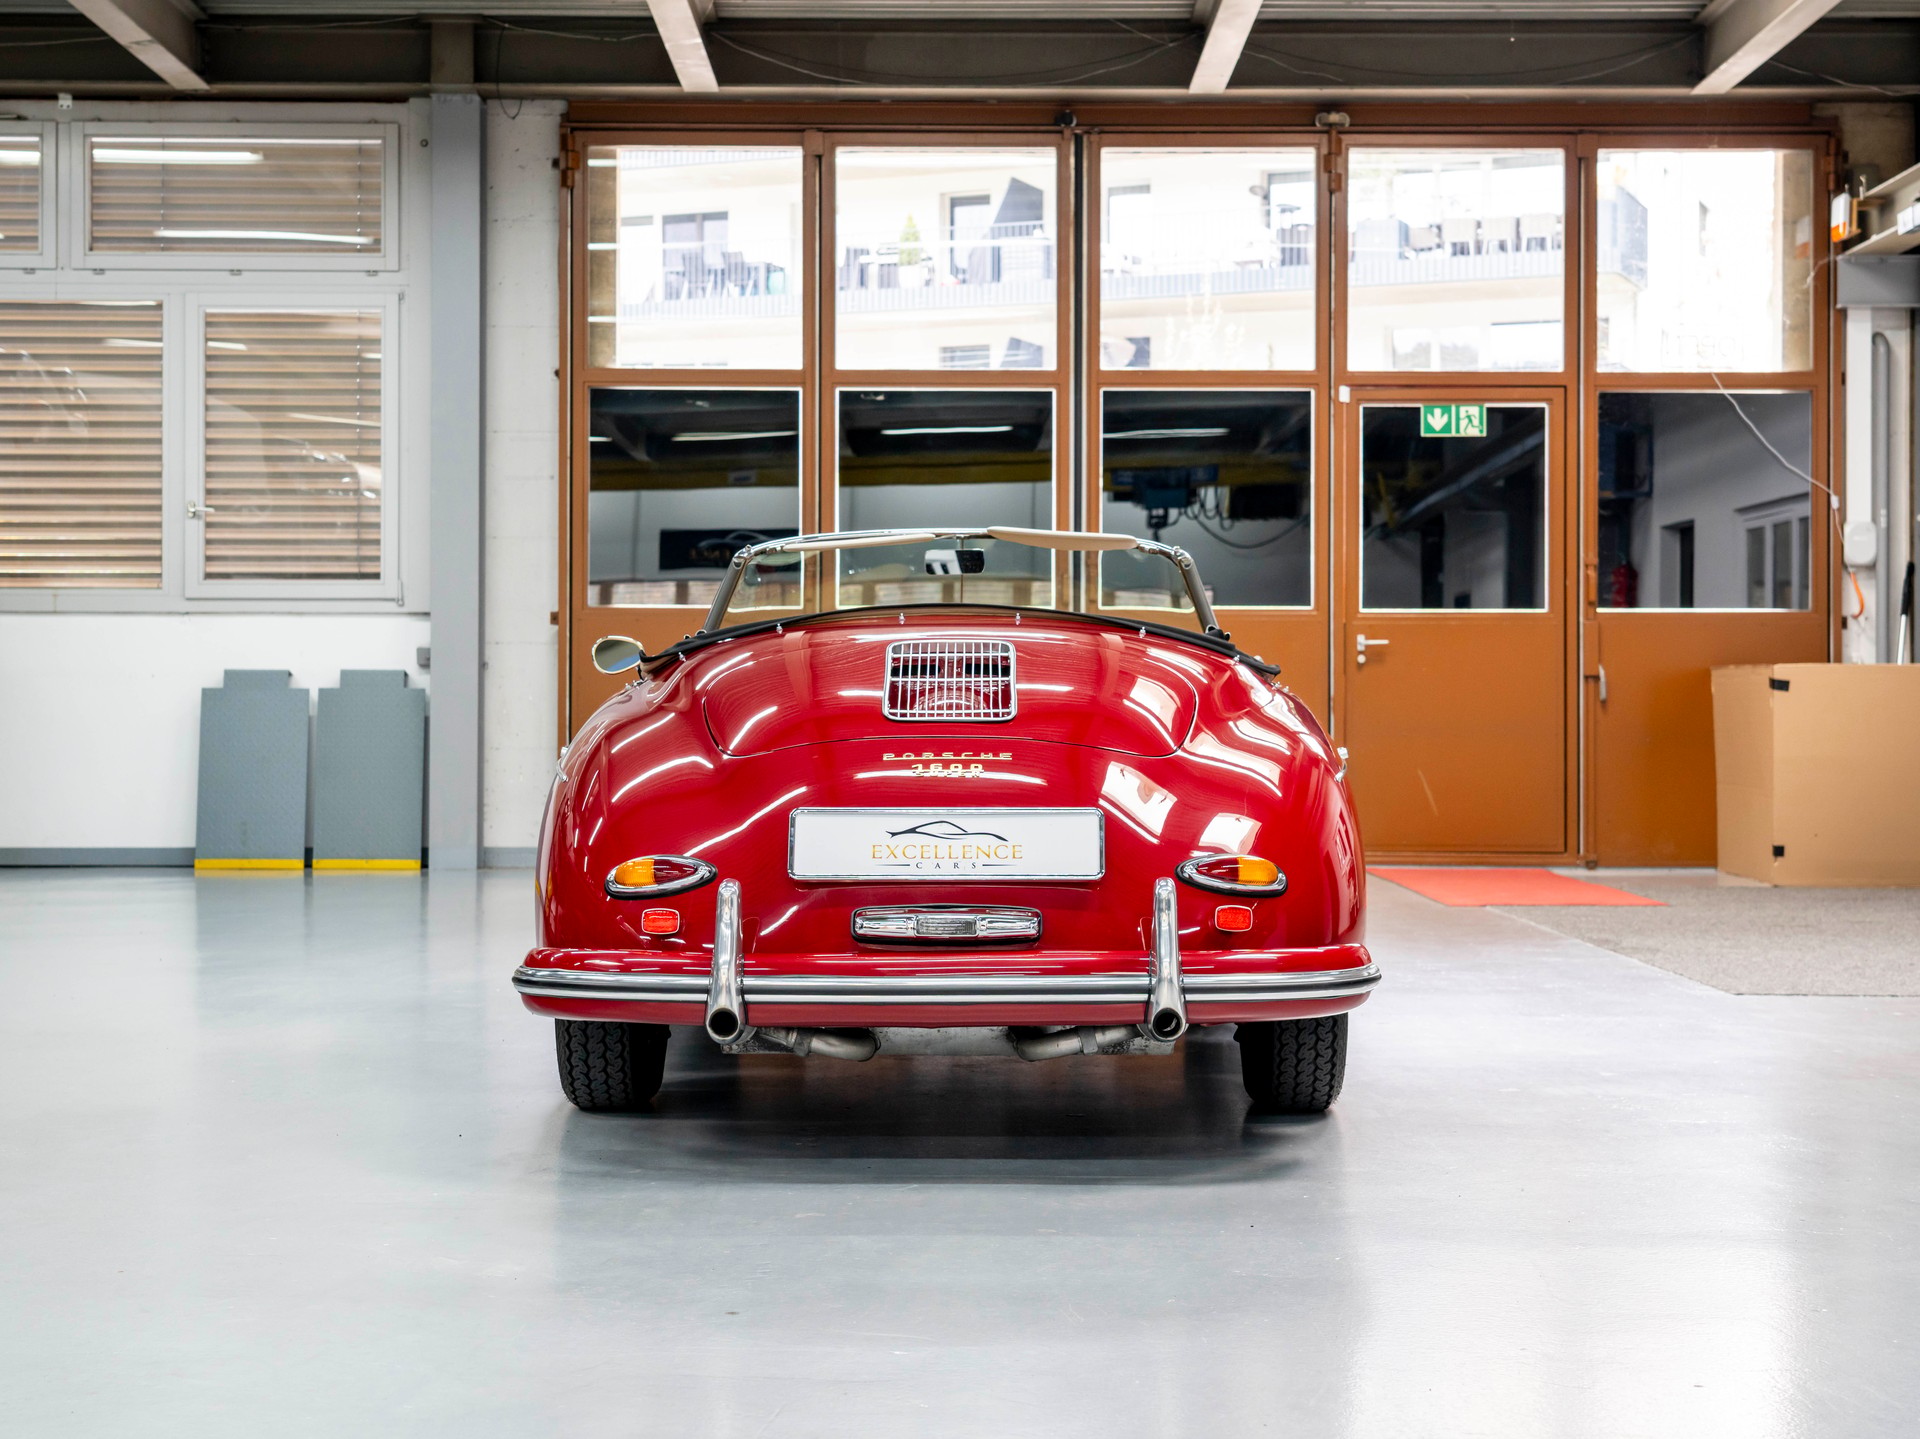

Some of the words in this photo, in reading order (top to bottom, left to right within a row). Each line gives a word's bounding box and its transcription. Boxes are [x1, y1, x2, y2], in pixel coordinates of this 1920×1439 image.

[883, 752, 1013, 760] PORSCHE
[871, 844, 1023, 860] EXCELLENCE
[916, 861, 977, 869] CARS
